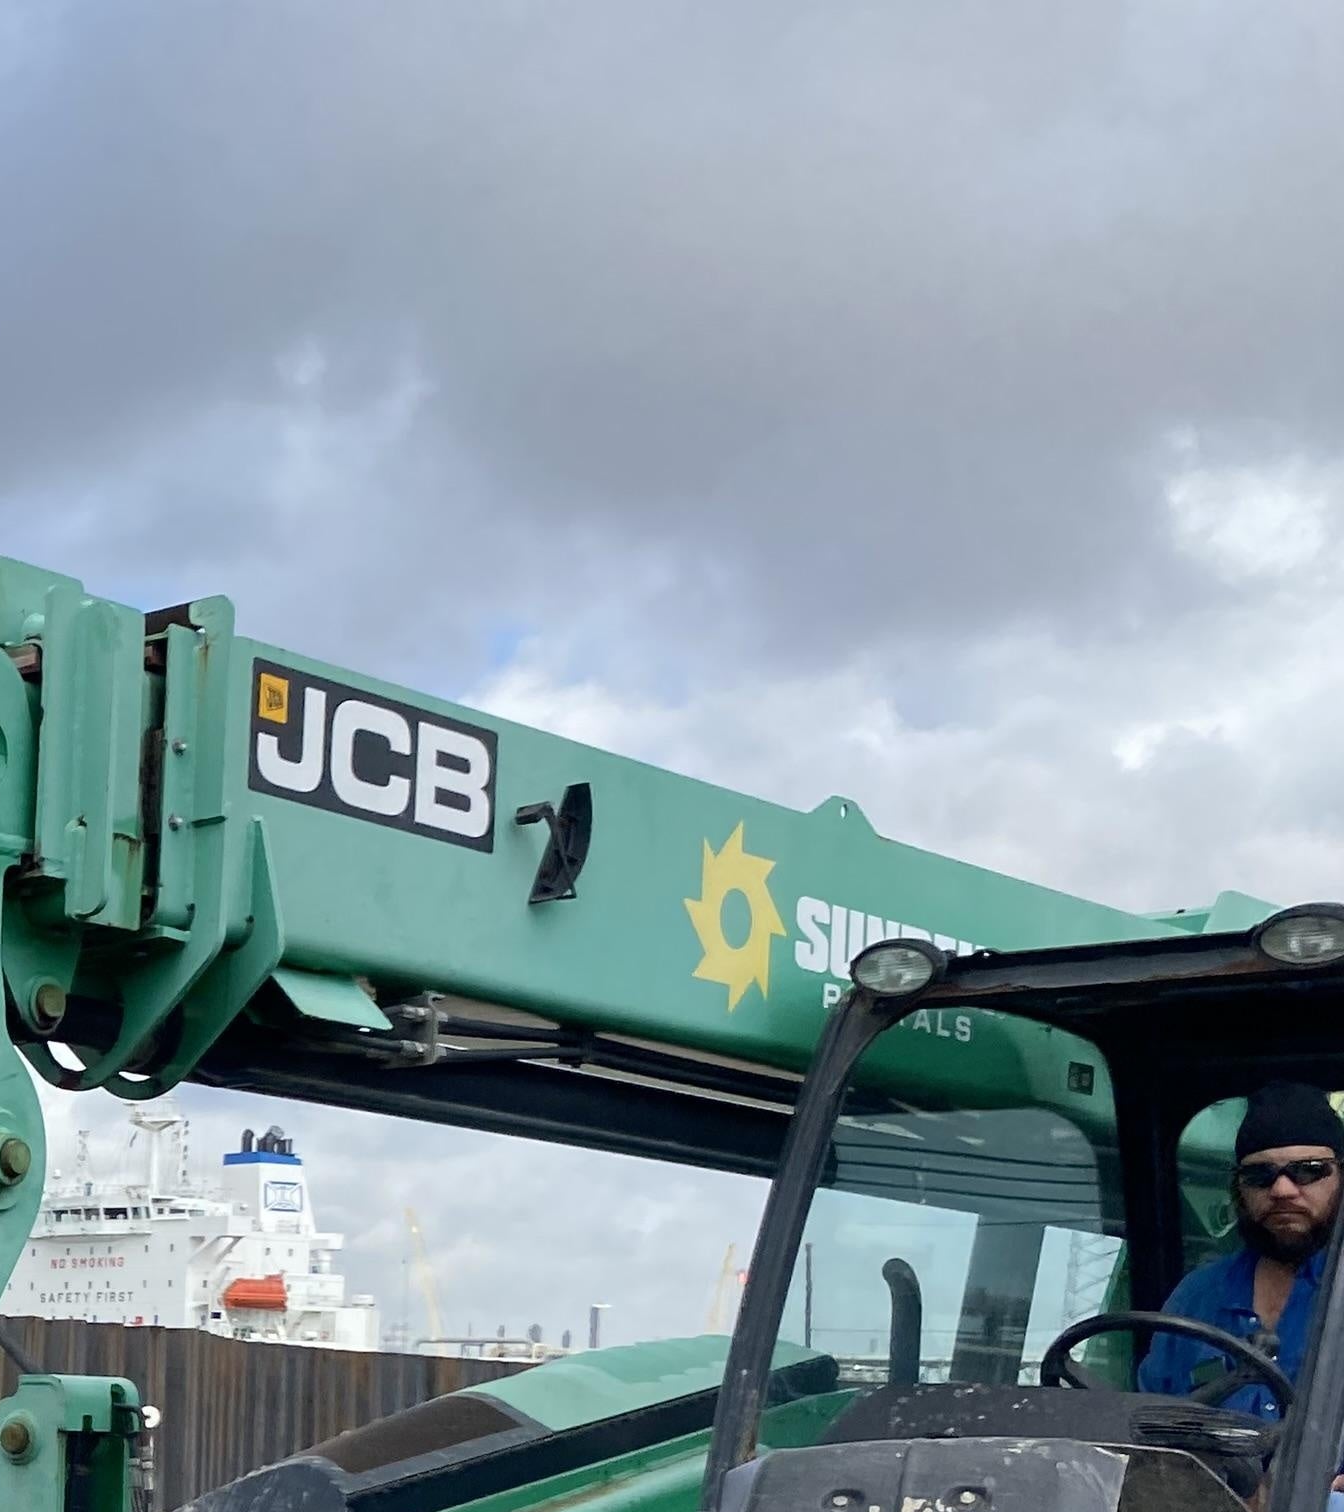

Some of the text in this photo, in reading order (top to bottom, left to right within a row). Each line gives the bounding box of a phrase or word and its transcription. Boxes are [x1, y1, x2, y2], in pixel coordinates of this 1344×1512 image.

[256, 687, 492, 841] JCB
[51, 1257, 124, 1269] NO SMOKING
[40, 1291, 134, 1304] SAFETY FIRST
